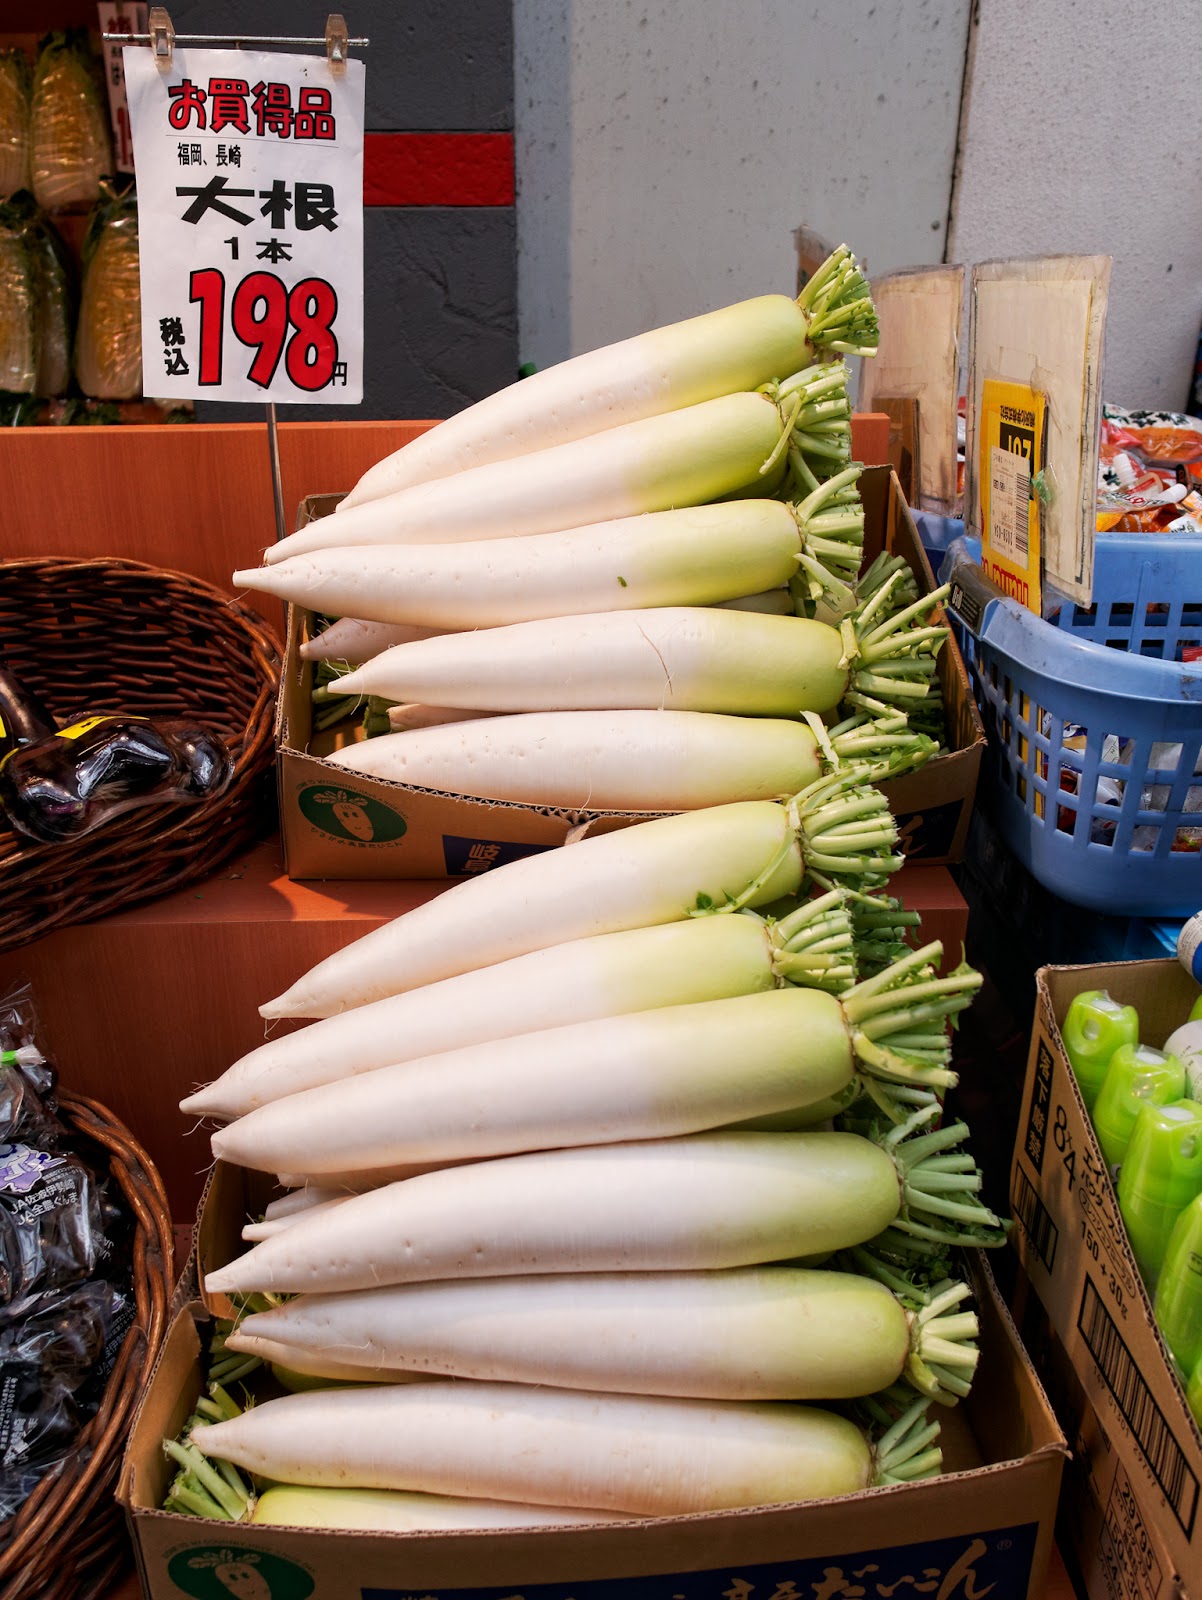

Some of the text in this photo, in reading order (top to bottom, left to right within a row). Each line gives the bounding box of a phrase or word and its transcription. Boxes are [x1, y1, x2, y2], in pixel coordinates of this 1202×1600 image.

[167, 77, 336, 141] お買得品
[177, 142, 242, 168] 福岡、長崎
[175, 175, 339, 233] 大根
[158, 316, 190, 377] 税込
[11, 1178, 76, 1215] JA佐波伊勢崎
[17, 1191, 79, 1226] JA全農ぐんま
